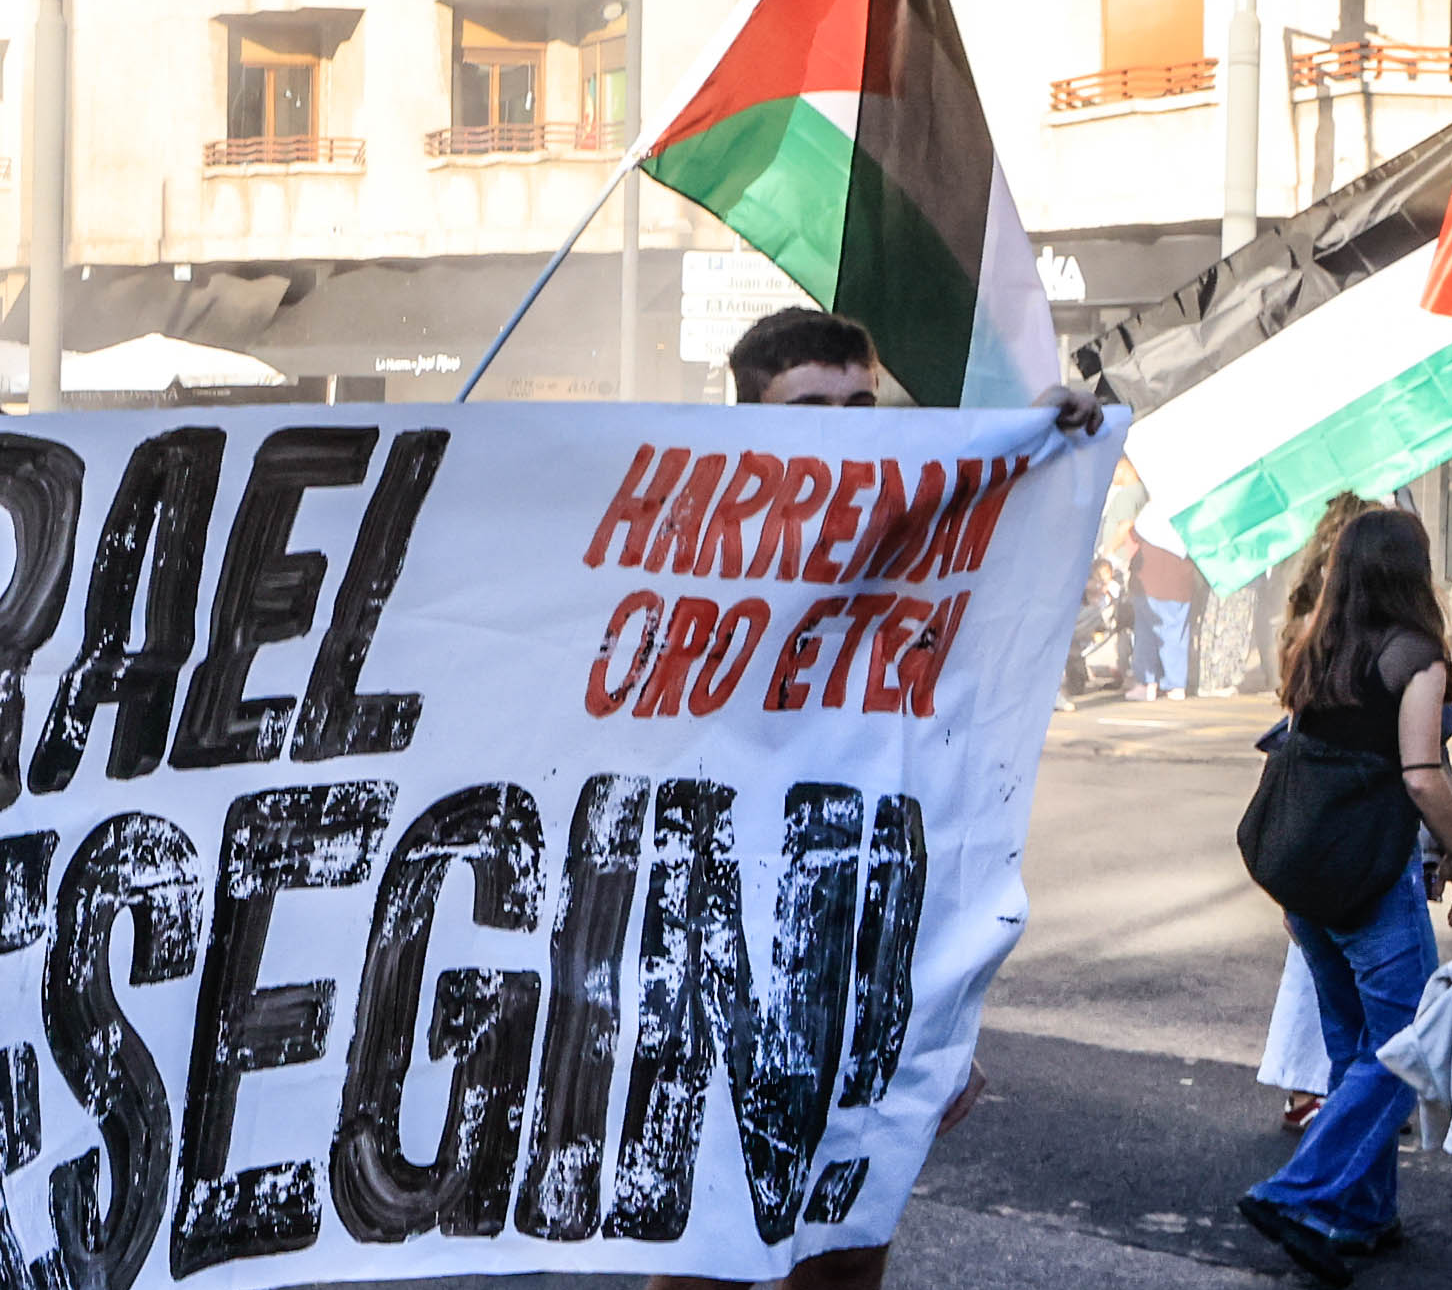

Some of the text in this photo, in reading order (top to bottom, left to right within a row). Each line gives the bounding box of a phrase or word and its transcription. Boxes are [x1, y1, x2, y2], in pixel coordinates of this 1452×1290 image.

[583, 443, 1030, 584] HARREMAN
[585, 589, 972, 718] ORO ETEN
